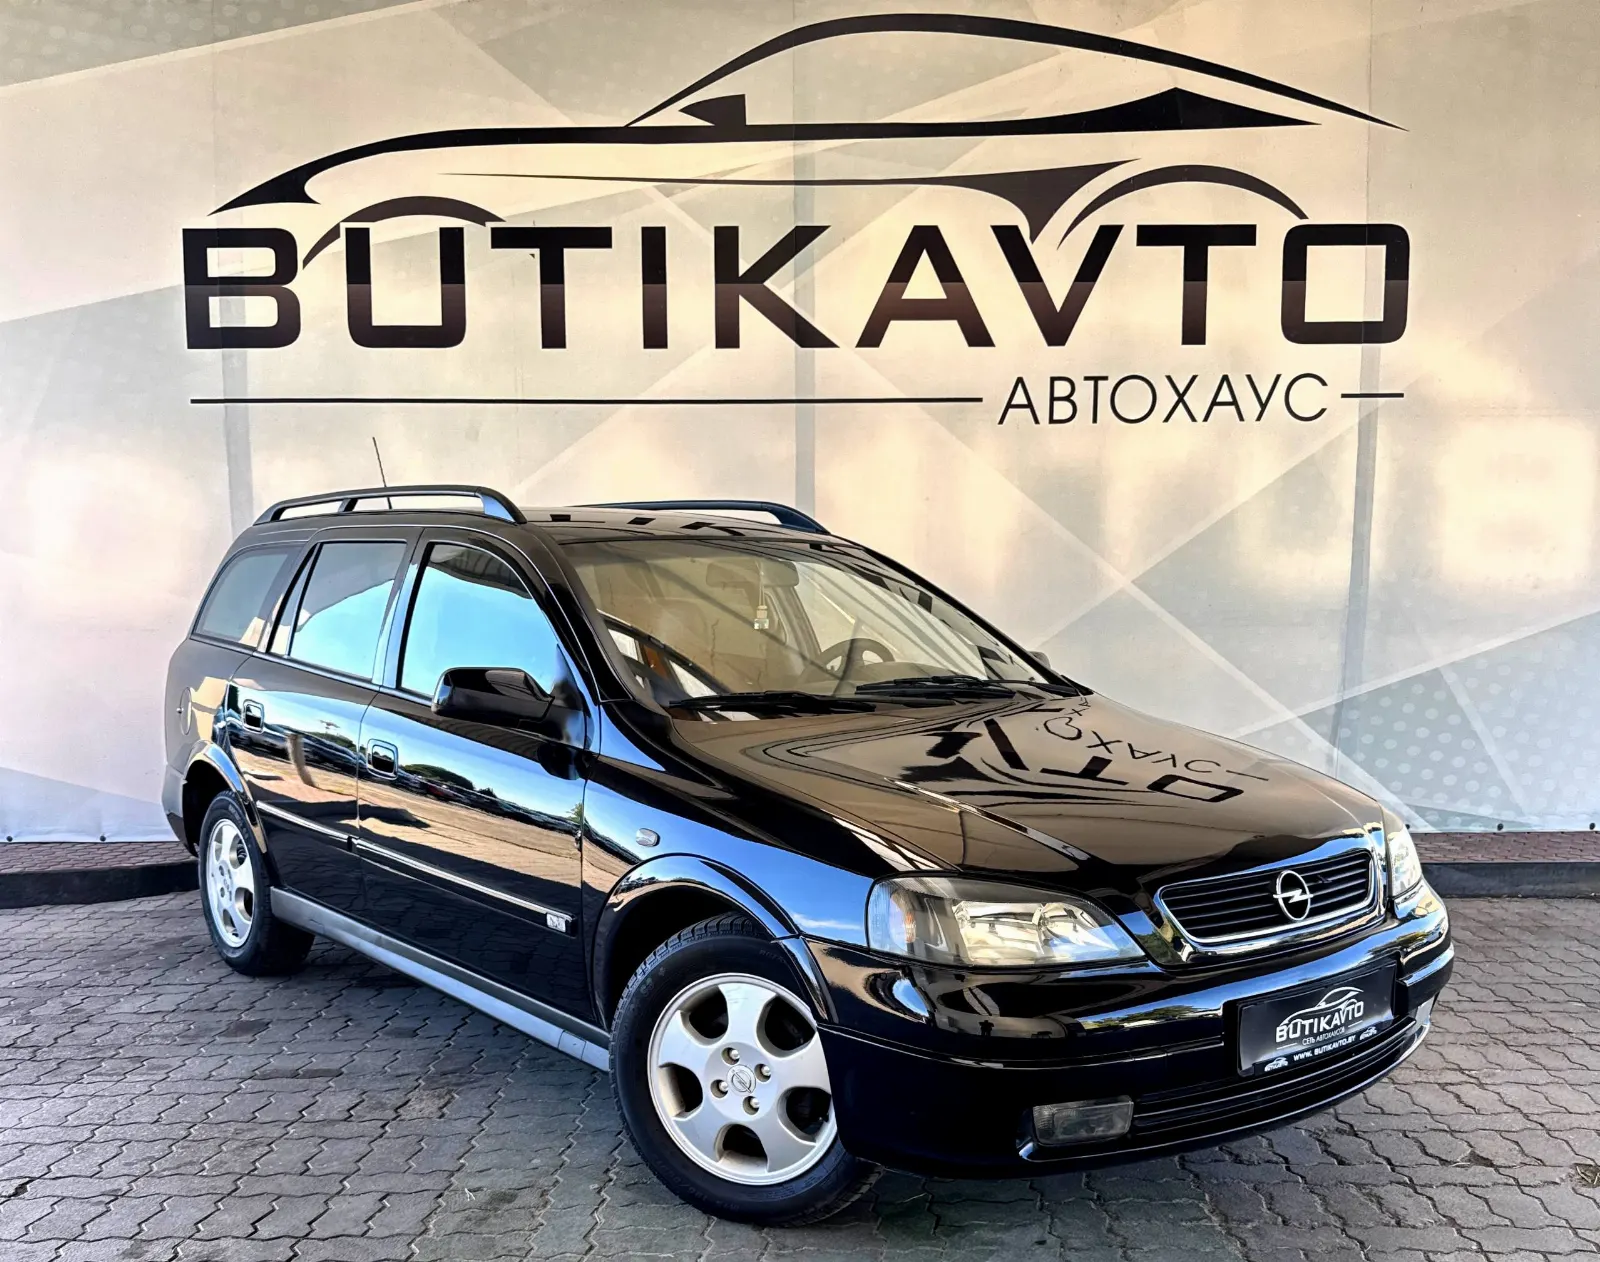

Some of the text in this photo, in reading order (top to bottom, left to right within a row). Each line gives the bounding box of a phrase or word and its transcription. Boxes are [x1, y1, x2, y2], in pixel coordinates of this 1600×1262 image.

[182, 223, 1411, 350] BUTIKAVTO
[997, 372, 1329, 426] АВТОХАУС
[1275, 1001, 1364, 1043] BUTIKAVTO
[1302, 1036, 1315, 1046] СЕТЬ
